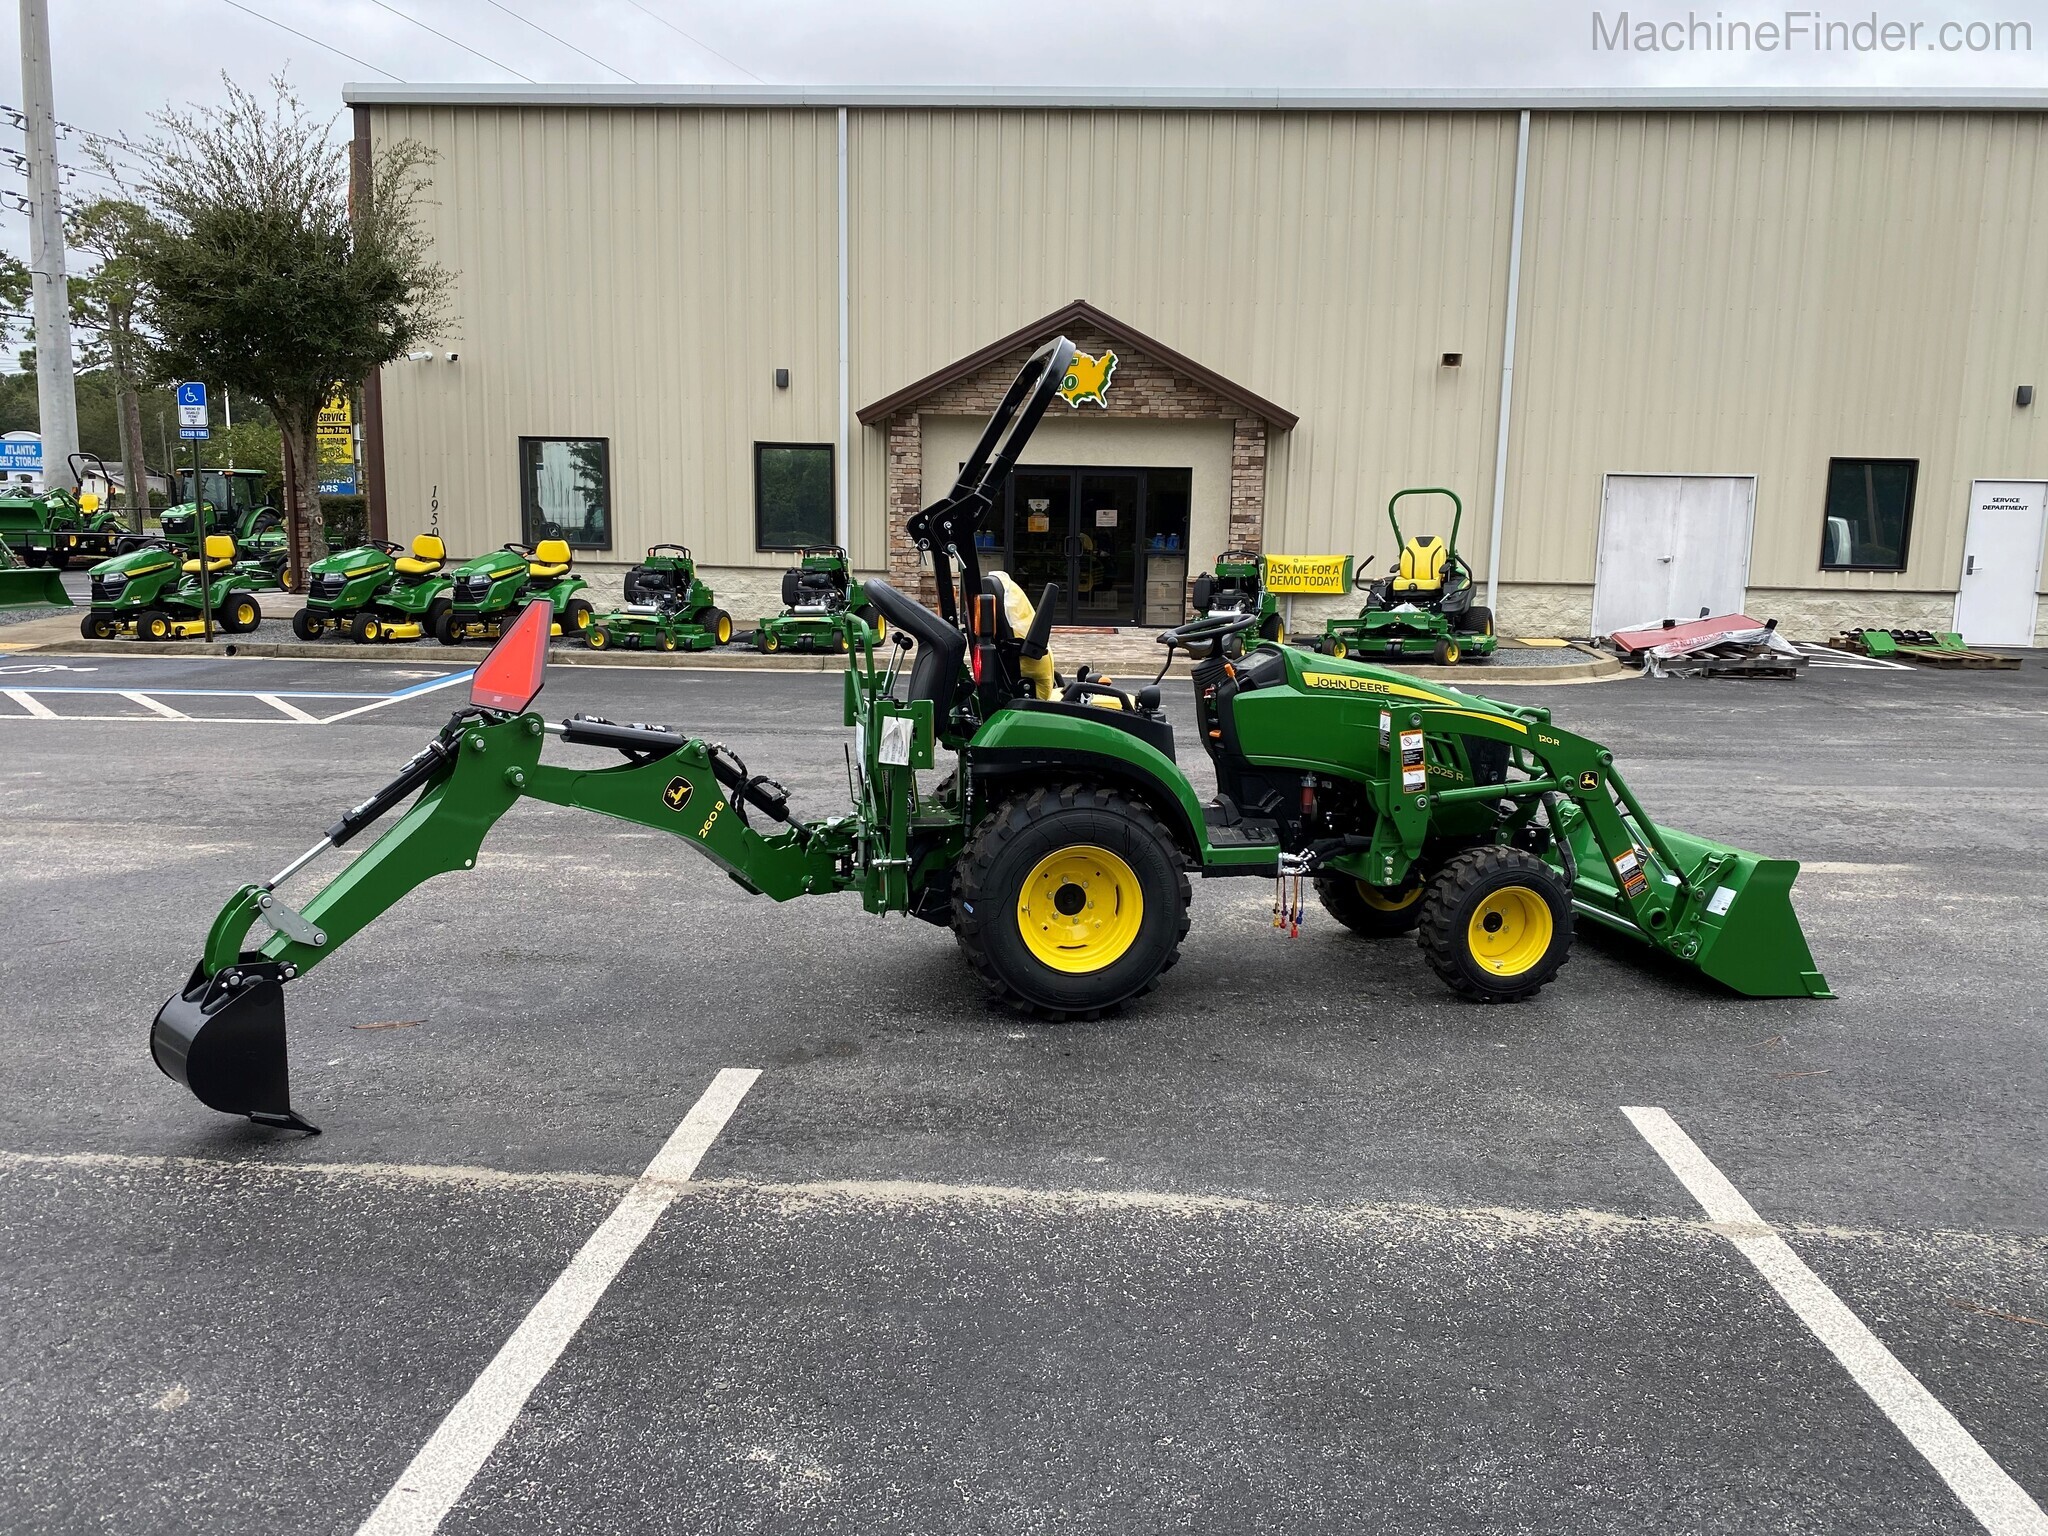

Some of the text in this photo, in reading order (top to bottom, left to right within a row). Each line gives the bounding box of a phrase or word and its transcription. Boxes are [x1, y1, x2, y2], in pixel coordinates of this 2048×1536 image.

[319, 412, 346, 421] SERVICE
[5, 444, 37, 455] ATLANTIC
[0, 456, 14, 467] SELF
[1270, 564, 1340, 575] ASK ME FOR A
[1269, 575, 1339, 586] DEMO TODAY!
[1313, 677, 1390, 693] JOHN DEERE
[1538, 734, 1560, 746] 120 R
[1427, 764, 1464, 781] 2025 R
[698, 800, 725, 839] 260 B
